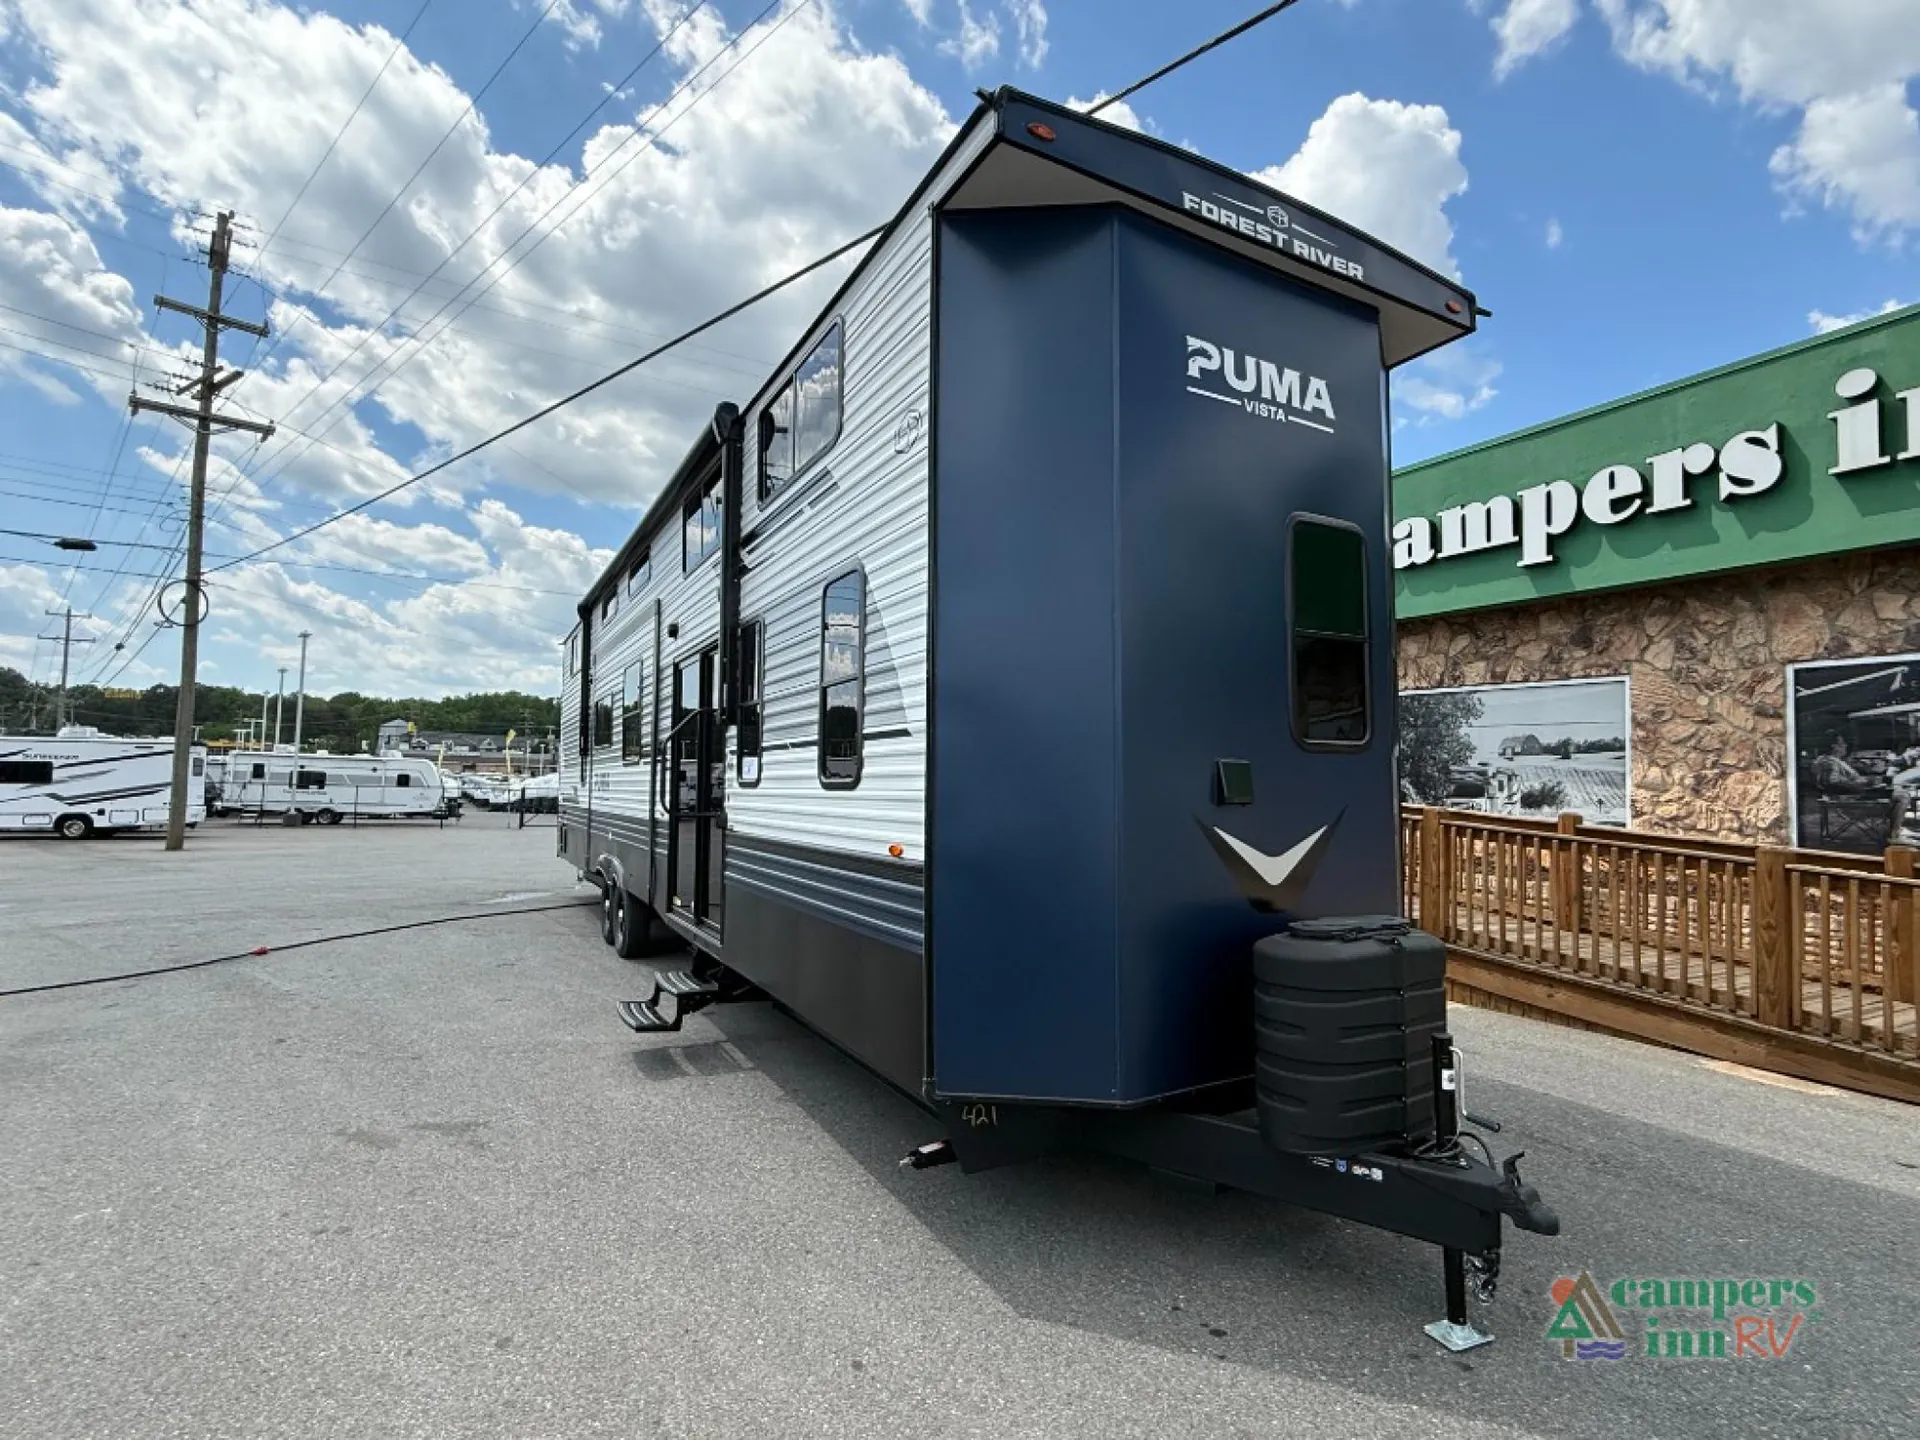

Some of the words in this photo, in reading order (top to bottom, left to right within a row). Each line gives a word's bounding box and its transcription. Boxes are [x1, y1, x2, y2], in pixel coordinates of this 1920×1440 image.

[1182, 191, 1289, 249] FOREST
[1293, 238, 1364, 281] RIVER
[1185, 334, 1336, 421] PUMA
[1244, 398, 1287, 422] VISTA
[1393, 421, 1783, 569] ampers
[961, 1104, 998, 1127] 421
